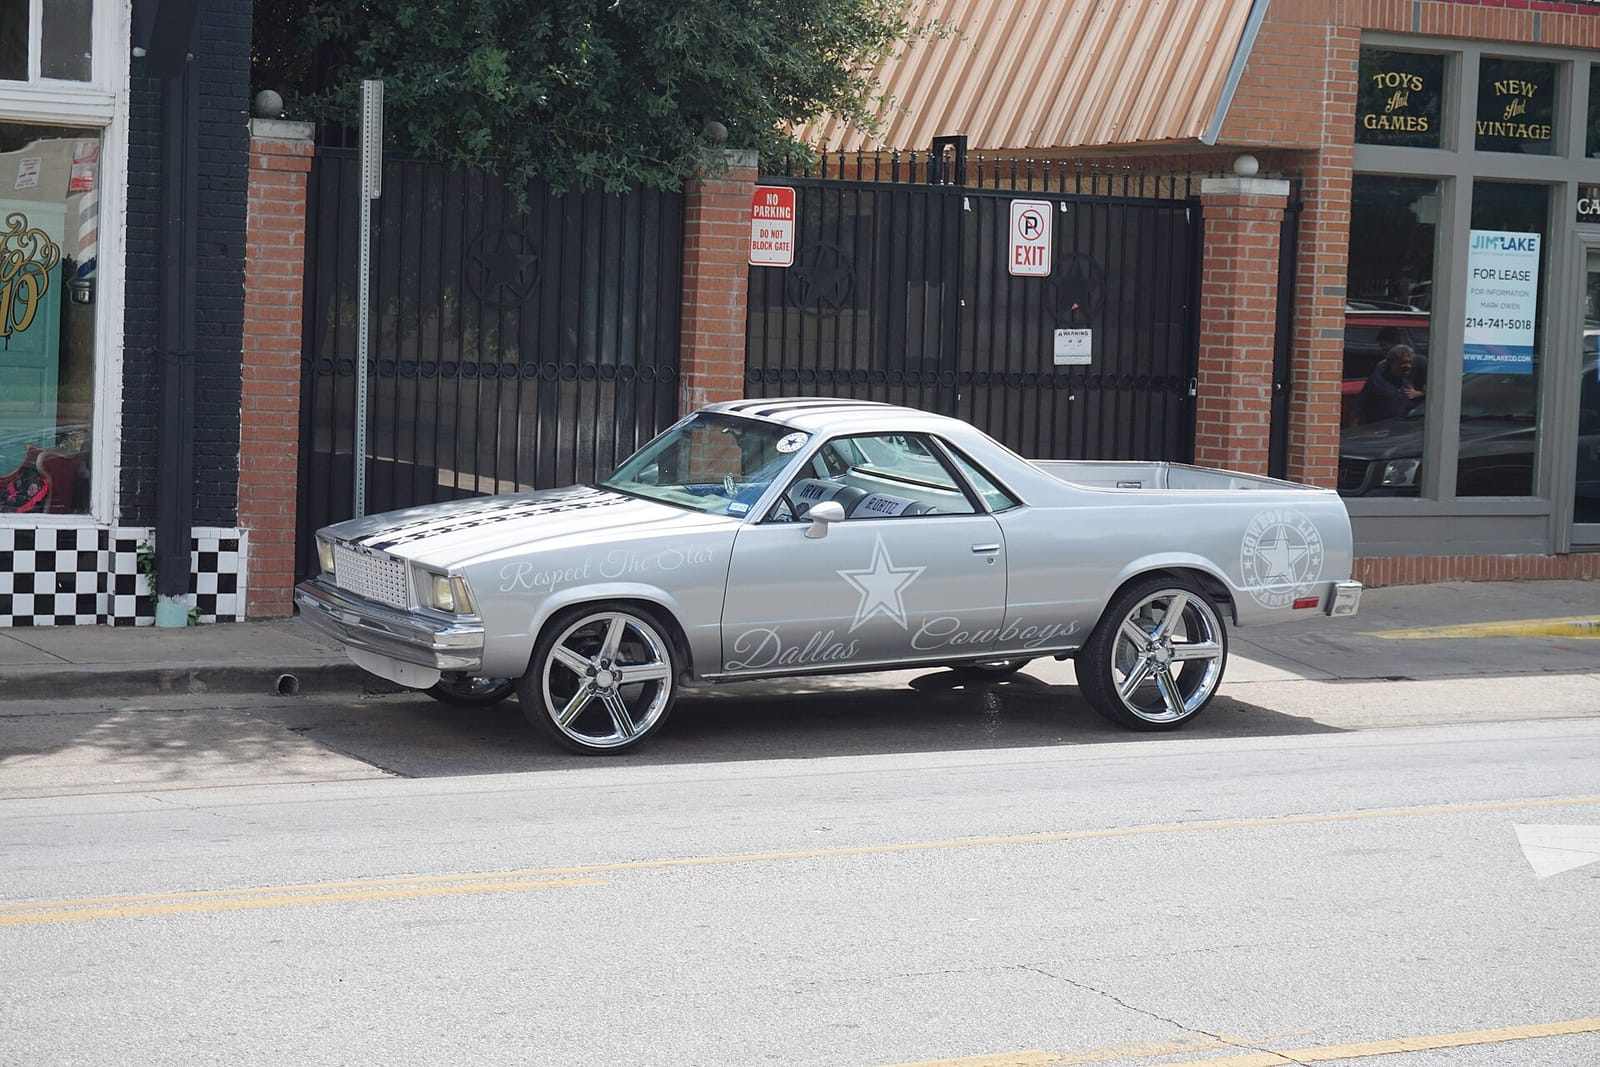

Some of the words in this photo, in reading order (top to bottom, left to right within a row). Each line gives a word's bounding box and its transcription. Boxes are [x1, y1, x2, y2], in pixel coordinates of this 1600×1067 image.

[1373, 72, 1424, 92] TOYS
[1494, 80, 1539, 98] NEW
[1363, 114, 1429, 132] GAMES
[1476, 120, 1551, 140] VINTAGE
[766, 194, 778, 205] NO
[753, 205, 791, 219] PARKING
[760, 229, 769, 239] DO
[771, 229, 784, 239] NOT
[752, 240, 773, 251] BLOCK
[774, 241, 790, 252] GATE
[1015, 245, 1046, 266] EXIT
[1473, 268, 1496, 280] FOR
[1498, 269, 1531, 281] LEASE
[1470, 287, 1484, 295] FOR
[1486, 289, 1530, 297] INFORMATION
[1500, 302, 1521, 310] OWEN
[1465, 317, 1532, 330] 214-741-5018
[499, 559, 592, 593] Respect
[600, 549, 650, 579] The
[657, 544, 713, 571] Star
[725, 626, 859, 671] Dallas
[910, 615, 1081, 651] Cowboys
